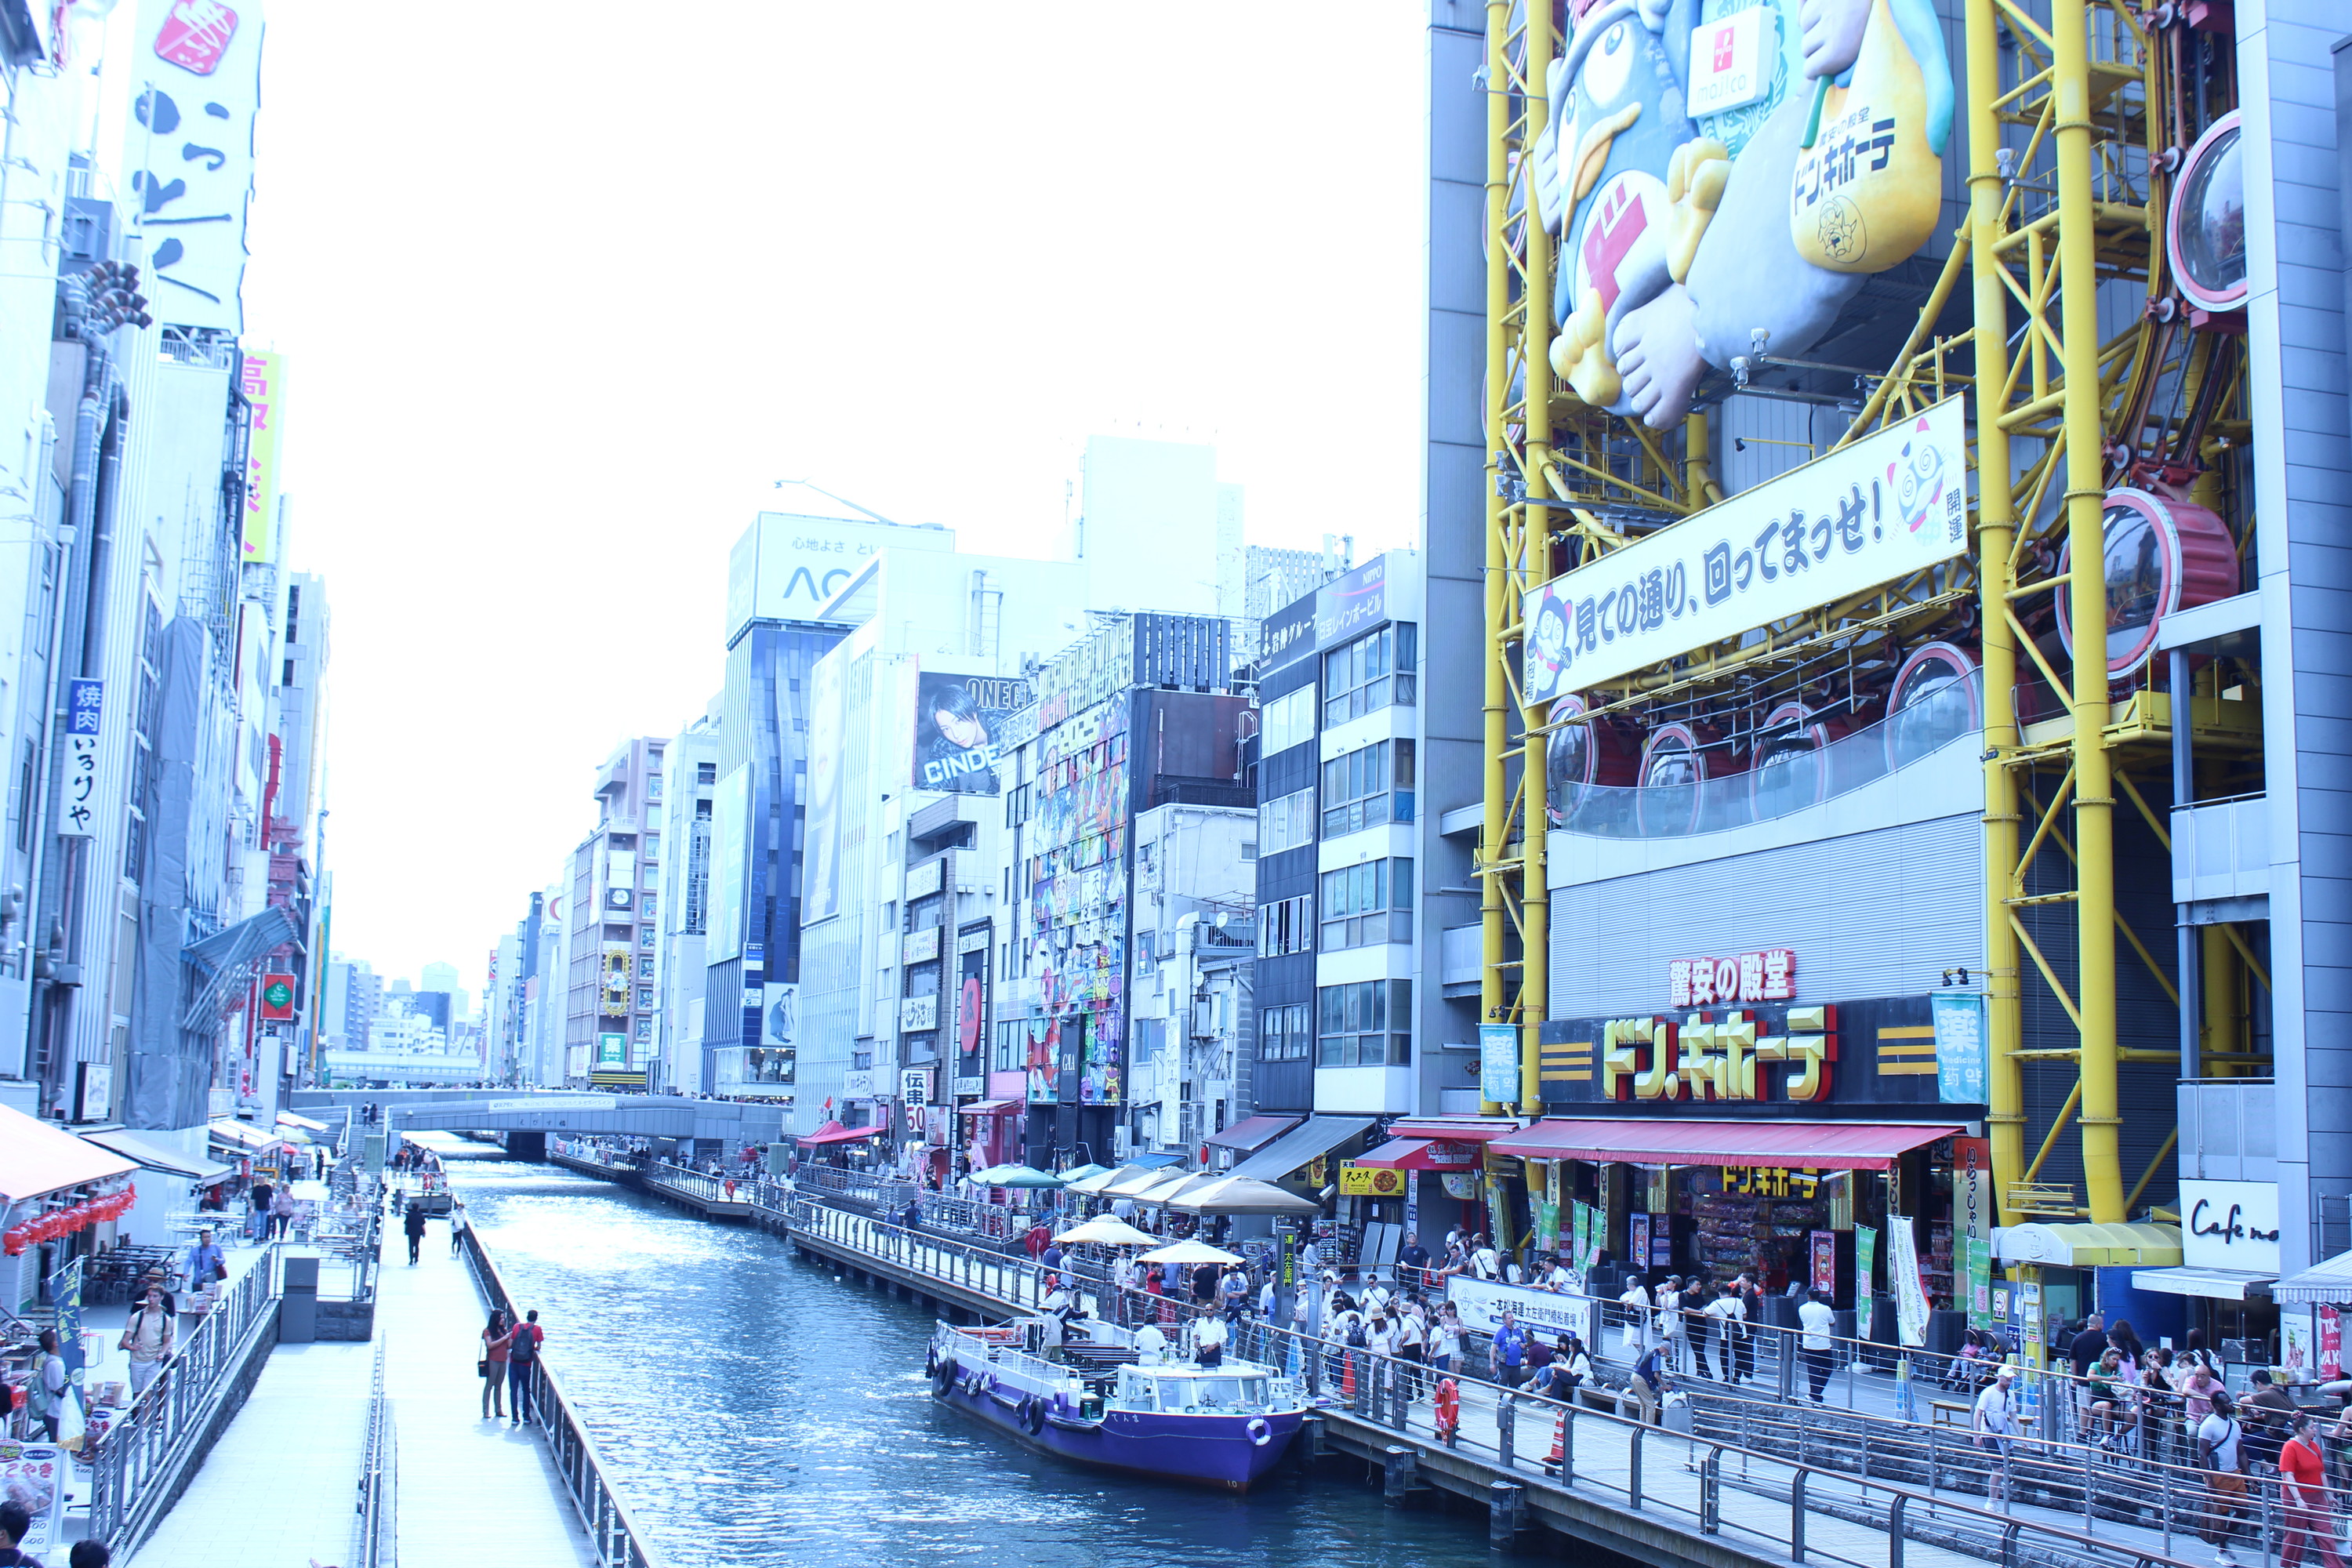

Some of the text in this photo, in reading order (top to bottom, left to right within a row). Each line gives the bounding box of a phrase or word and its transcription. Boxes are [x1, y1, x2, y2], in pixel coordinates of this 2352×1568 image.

[1945, 487, 1962, 545] 開運
[792, 537, 845, 554] 心地よさ
[1363, 566, 1381, 584] NIPPO
[1319, 593, 1381, 641] 日宝レインボービル
[75, 684, 102, 732] 焼肉
[71, 738, 94, 831] いろりや
[1669, 949, 1791, 1006] 驚安の殿堂
[604, 1037, 622, 1054] 薬
[1938, 1008, 1980, 1052] 薬
[1484, 1036, 1514, 1066] 薬
[906, 1073, 924, 1105] 伝串
[1944, 1067, 1959, 1087] 药
[1965, 1068, 1983, 1087] 약
[906, 1106, 925, 1131] 50
[2191, 1198, 2243, 1244] Cafe
[1283, 1251, 1293, 1288] 太左衛門
[1111, 1414, 1140, 1423] てんま
[0, 1462, 54, 1479] こやき
